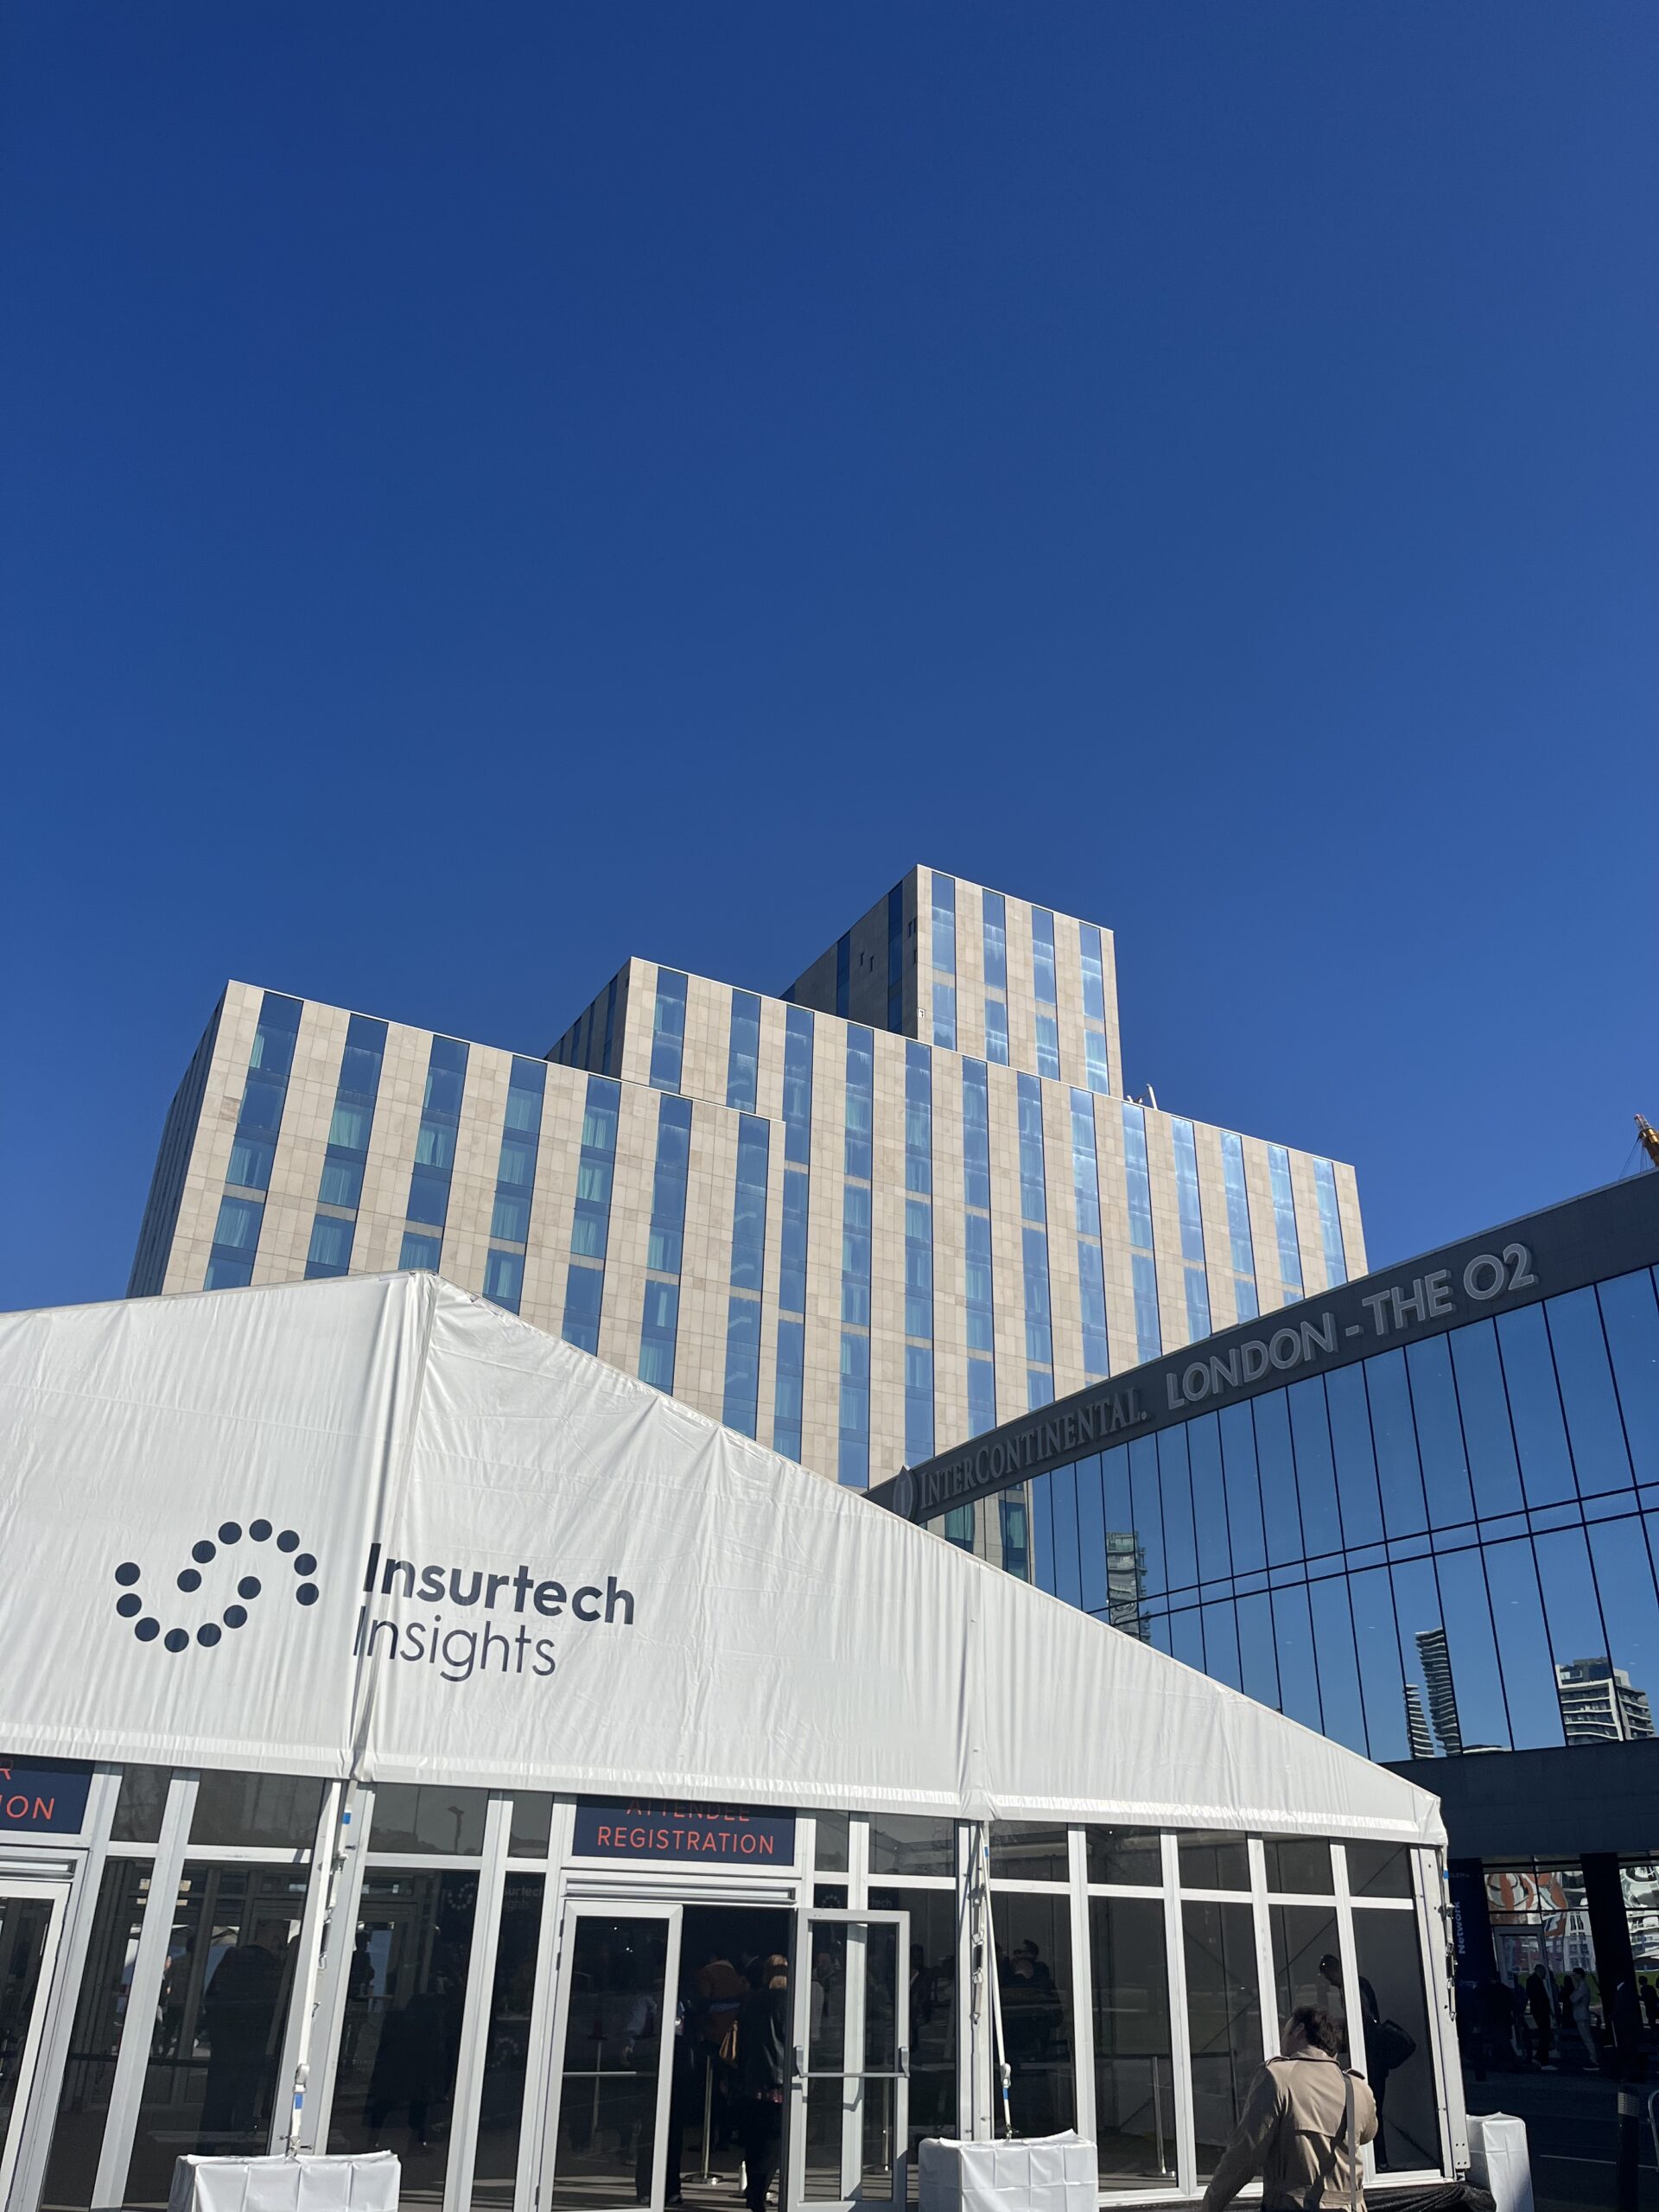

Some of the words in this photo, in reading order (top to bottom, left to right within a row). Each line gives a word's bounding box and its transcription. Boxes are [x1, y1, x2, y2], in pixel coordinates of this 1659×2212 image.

[1165, 1312, 1338, 1411] LONDON
[1361, 1269, 1457, 1337] THE
[1463, 1243, 1539, 1300] O2
[363, 1542, 635, 1625] Insurtech
[353, 1605, 556, 1682] Insights
[597, 1826, 774, 1854] REGISTRATION
[1453, 1901, 1466, 1955] Network
